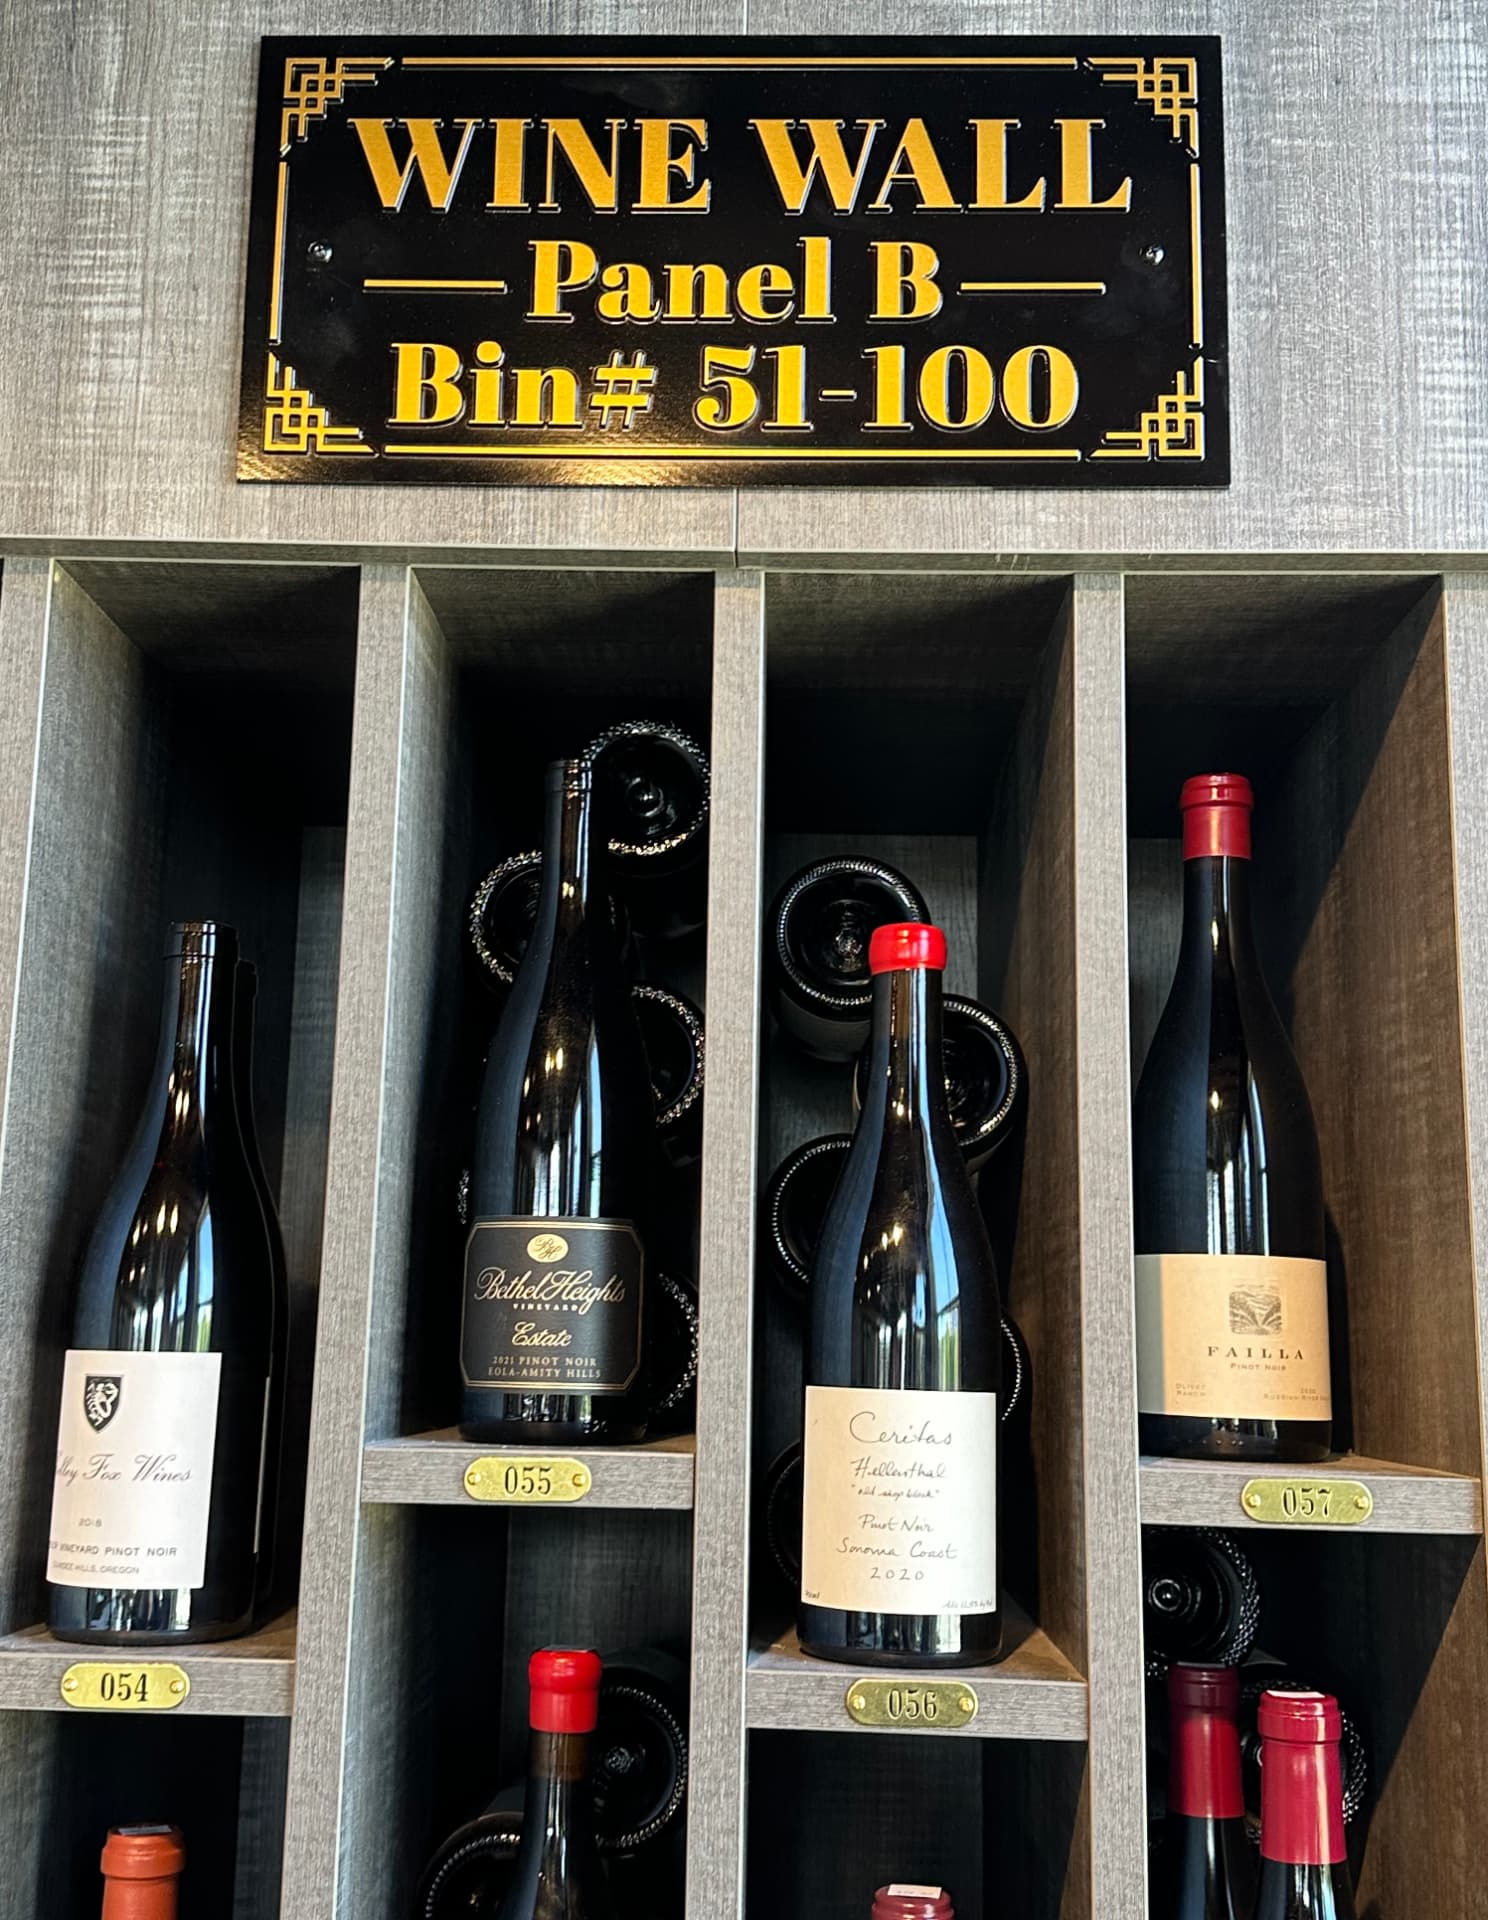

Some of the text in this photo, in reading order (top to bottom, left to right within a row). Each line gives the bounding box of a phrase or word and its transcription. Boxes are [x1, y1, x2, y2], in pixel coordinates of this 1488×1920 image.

[347, 117, 1133, 215] WINE WALL
[524, 236, 944, 324] Panel B
[386, 340, 1080, 433] Bin# 51-100
[474, 1266, 626, 1315] Bethel Heights
[513, 1303, 579, 1312] VINEYARD
[511, 1321, 573, 1347] Estate
[518, 1356, 559, 1366] PINOT
[565, 1357, 597, 1367] NOIR
[1207, 1345, 1304, 1360] FAILLA
[488, 1366, 601, 1378] EOLA-AMITY HILLS
[849, 1411, 952, 1446] Ceritas
[83, 1453, 122, 1481] Fox
[132, 1453, 193, 1482] Wines
[503, 1465, 551, 1495] 055
[1281, 1486, 1333, 1517] 057
[104, 1546, 140, 1557] PINOT
[146, 1547, 178, 1557] NOIR
[836, 1537, 958, 1560] Sonoma Coast
[99, 1564, 140, 1575] OREGON
[869, 1566, 925, 1581] 2020
[99, 1672, 149, 1703] 054
[887, 1687, 938, 1720] 056
